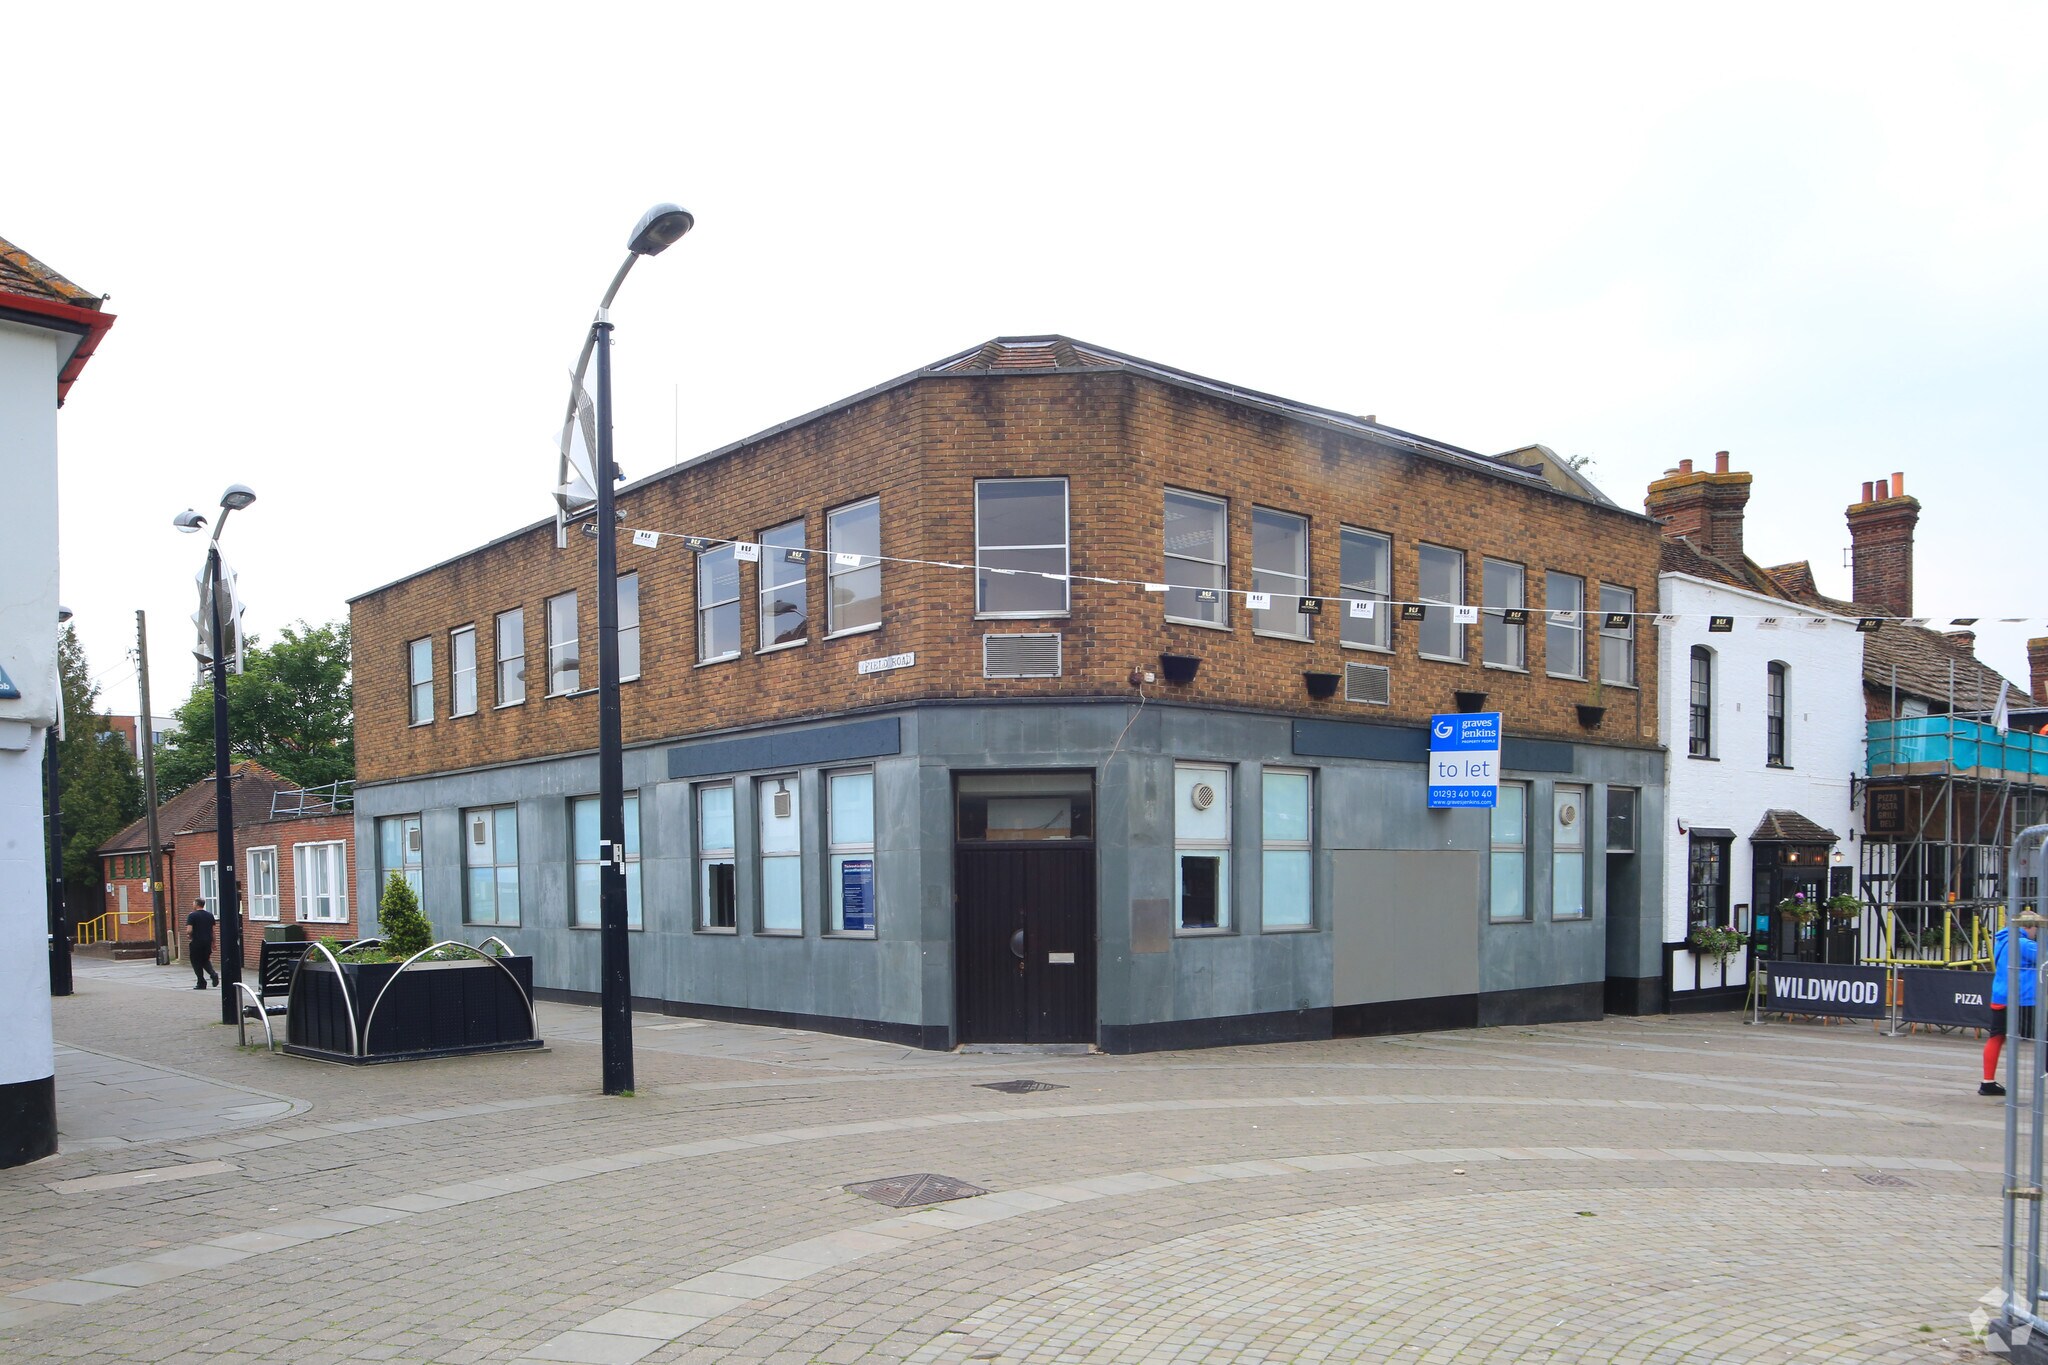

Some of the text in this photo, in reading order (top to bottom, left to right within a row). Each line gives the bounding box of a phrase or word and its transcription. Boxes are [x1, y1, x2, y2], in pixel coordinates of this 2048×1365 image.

[892, 655, 912, 667] ROAD
[1462, 720, 1492, 729] graves
[1461, 728, 1496, 740] jenkins
[1438, 760, 1490, 778] to let
[1433, 790, 1457, 798] 01293
[1774, 975, 1879, 1004] WILDWOOD
[1954, 992, 1983, 1006] PIZZA
